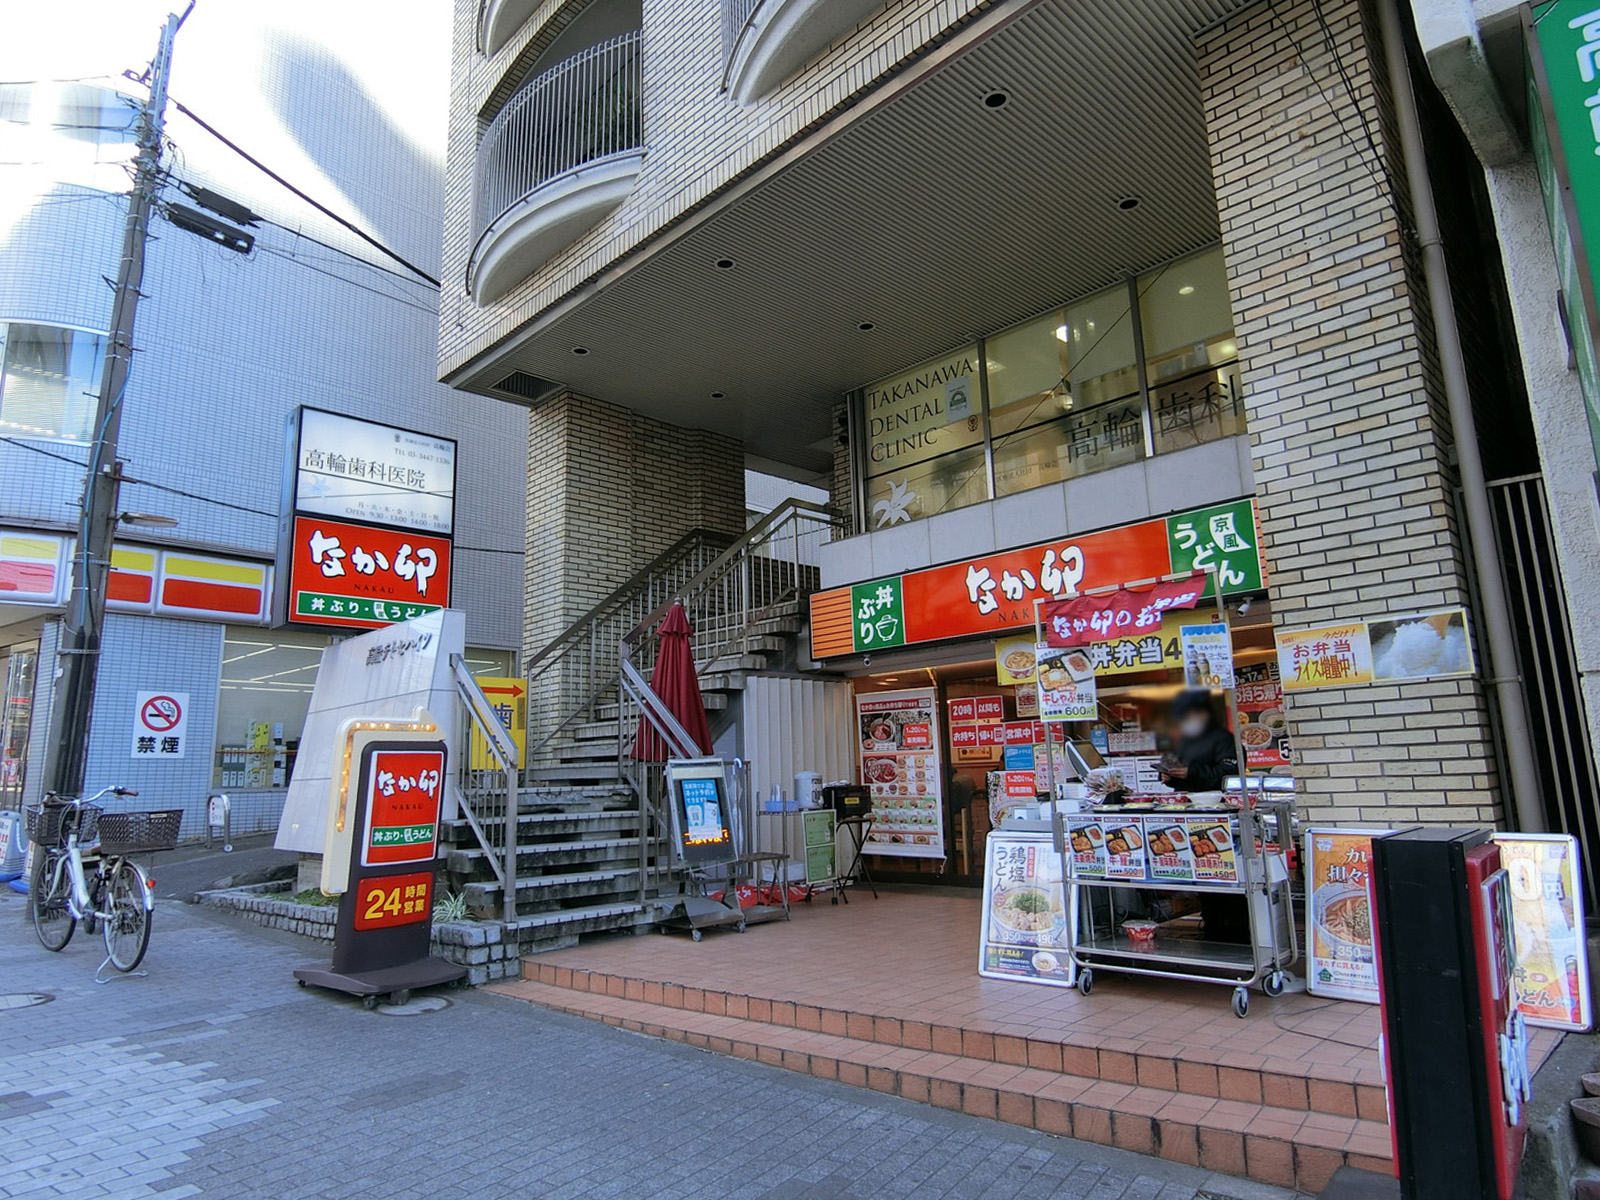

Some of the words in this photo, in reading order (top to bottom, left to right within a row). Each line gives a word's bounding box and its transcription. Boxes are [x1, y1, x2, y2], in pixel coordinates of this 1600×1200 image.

[868, 358, 974, 410] TAKANAWA
[870, 398, 944, 438] DENTAL
[1063, 374, 1245, 464] 高輪歯科
[870, 427, 938, 463] CLINIC
[305, 448, 426, 490] 高輪歯科医院
[1213, 516, 1240, 550] 京風
[308, 529, 438, 598] なか卯
[1173, 522, 1246, 589] うどん
[353, 583, 395, 594] NAKAU
[965, 544, 1086, 616] なか卯
[857, 584, 895, 645] 丼ぶり
[997, 606, 1031, 623] NAK
[1292, 639, 1352, 659] お弁当
[137, 735, 180, 754] 禁煙
[377, 769, 439, 800] なか卯
[392, 803, 423, 811] NAKAU
[993, 846, 1008, 892] うどん
[1008, 846, 1027, 883] 鶏塩
[363, 887, 402, 920] 24
[404, 883, 427, 899] 時間
[403, 898, 426, 915] 営業
[1337, 945, 1361, 958] 350
[1515, 986, 1556, 1008] どん
